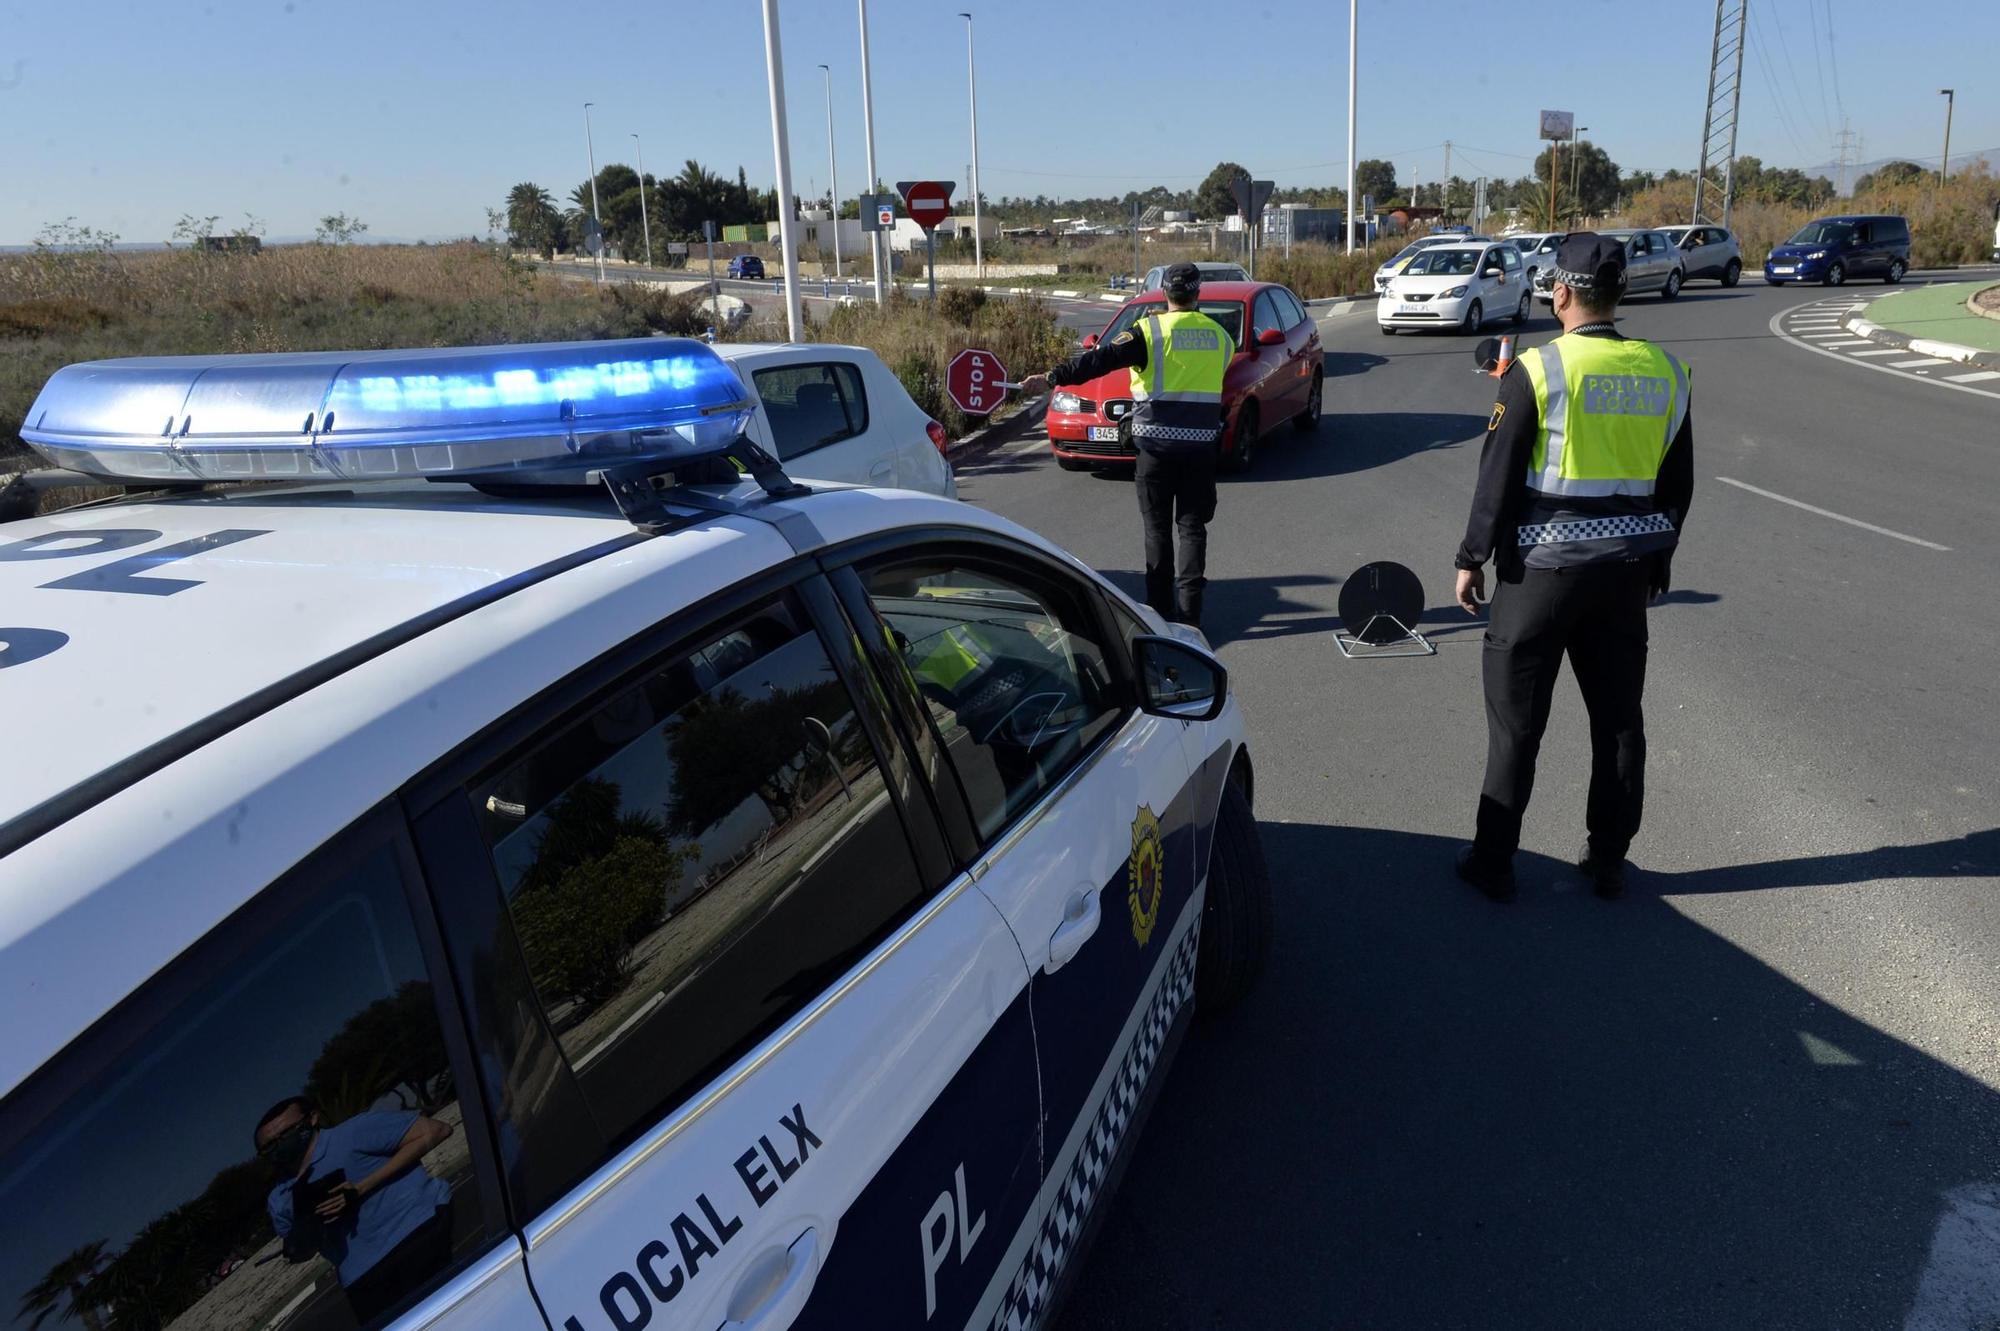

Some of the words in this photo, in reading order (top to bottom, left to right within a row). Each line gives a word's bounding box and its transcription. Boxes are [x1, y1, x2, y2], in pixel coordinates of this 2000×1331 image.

[1178, 340, 1212, 349] LOCAL
[969, 355, 985, 407] STOP
[1596, 396, 1656, 412] LOCAL
[732, 1102, 824, 1208] ELX
[919, 1161, 987, 1322] PL
